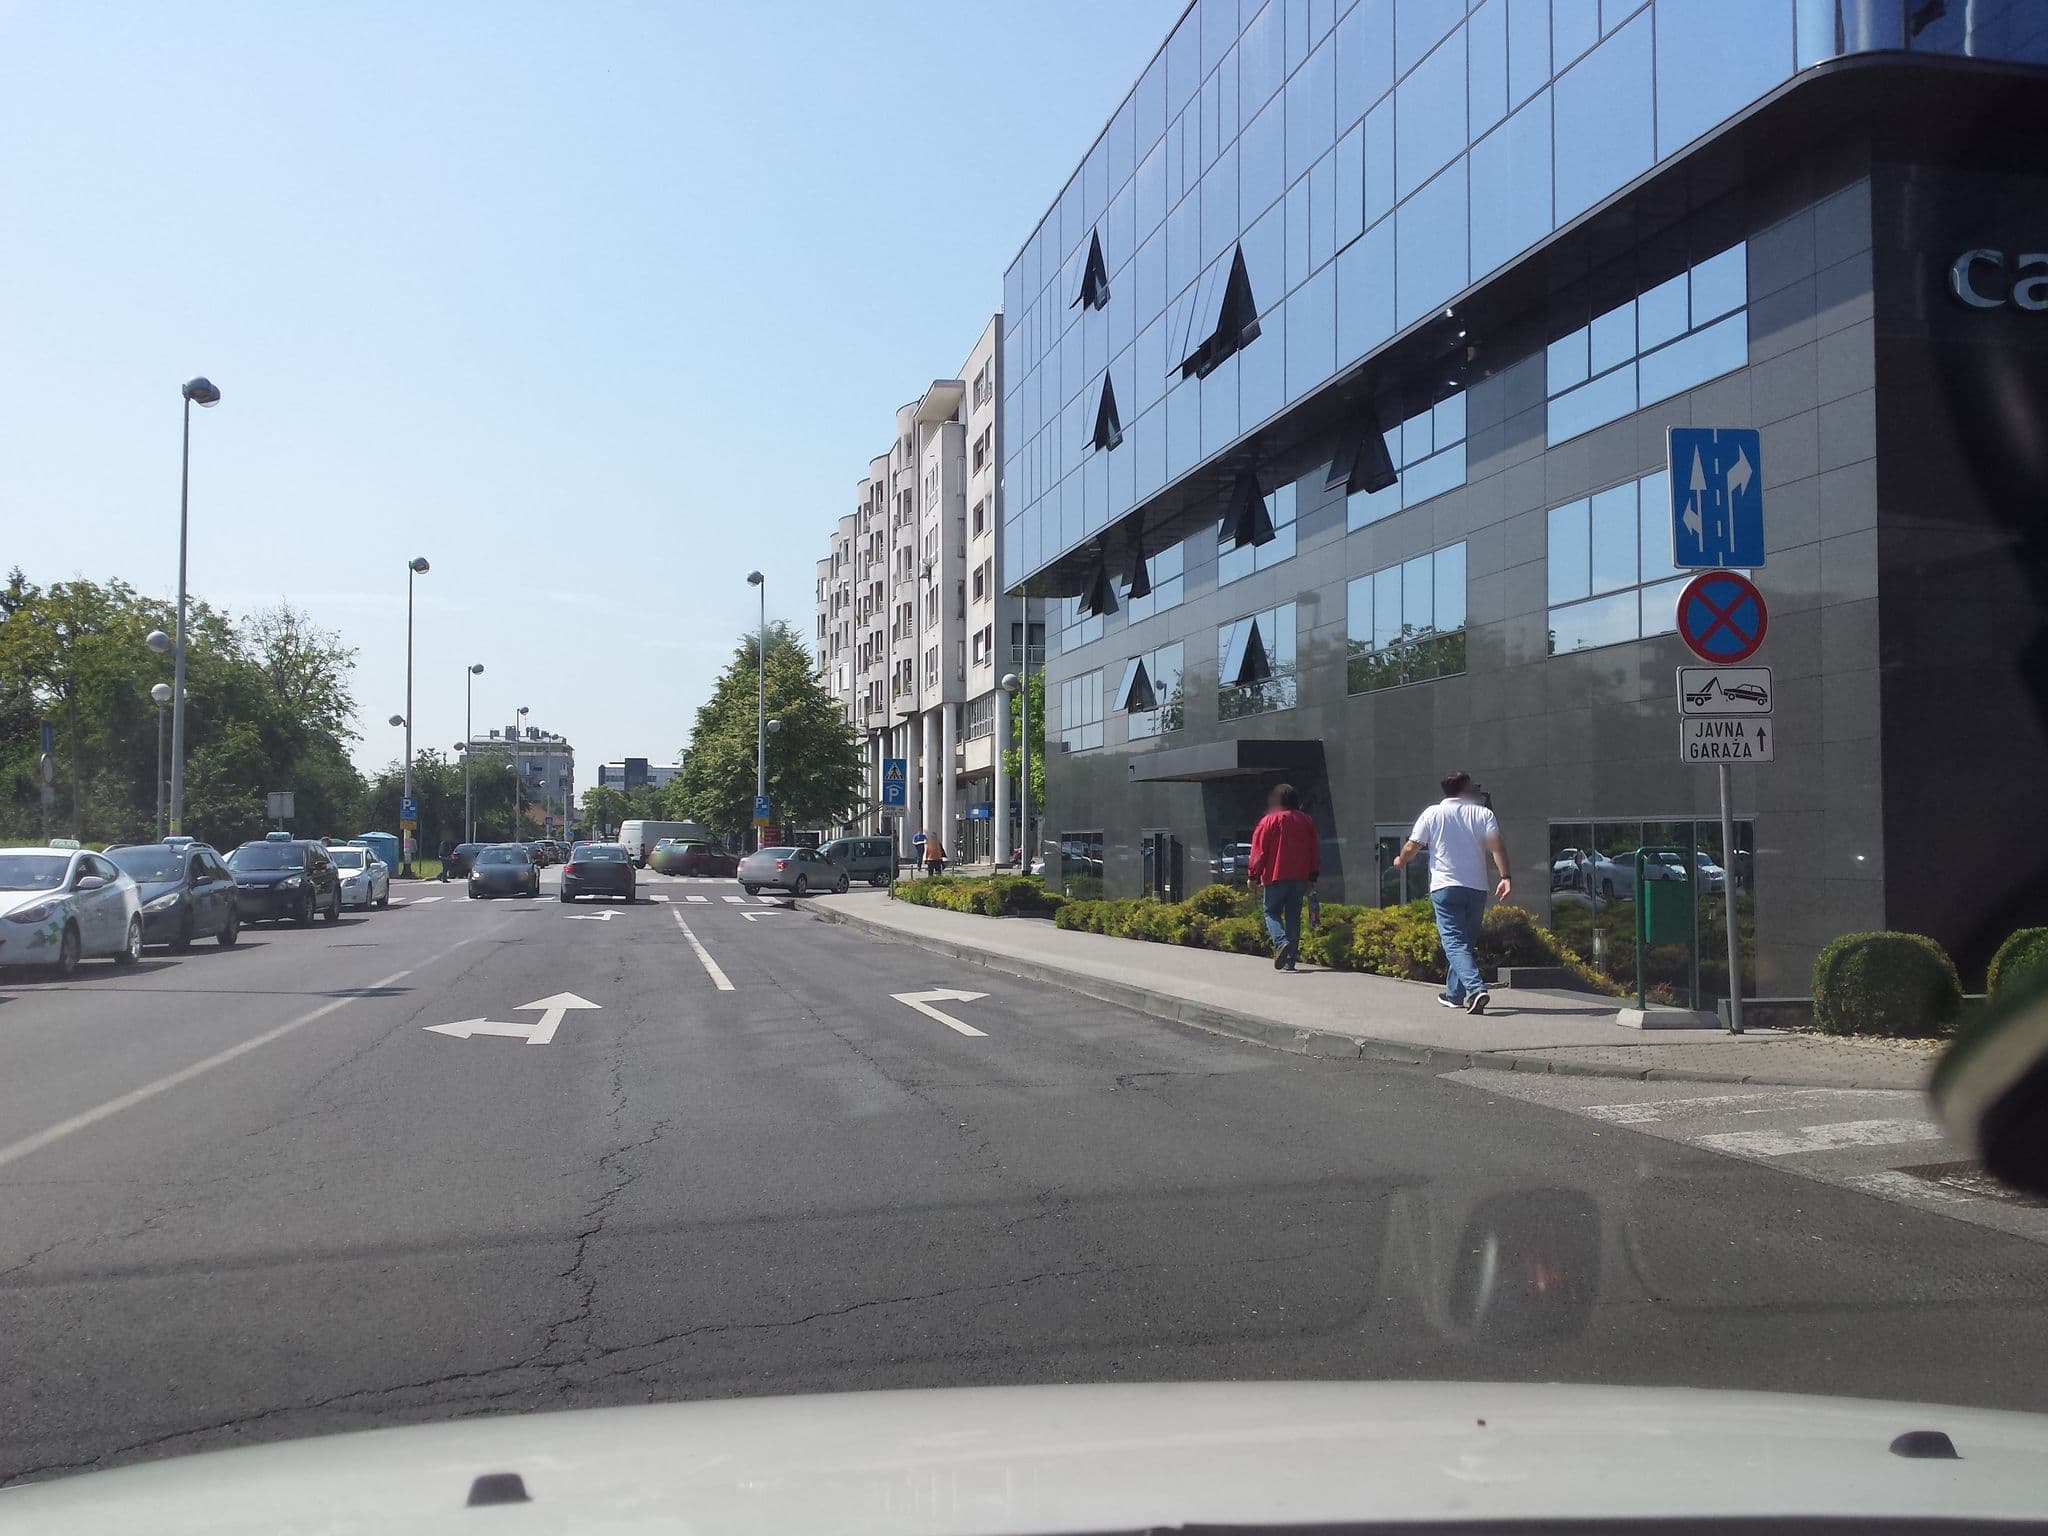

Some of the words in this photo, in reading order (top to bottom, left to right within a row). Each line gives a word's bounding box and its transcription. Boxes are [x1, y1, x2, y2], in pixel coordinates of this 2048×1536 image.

[1695, 722, 1744, 738] JAVNA
[888, 788, 899, 803] P
[403, 799, 411, 810] P
[755, 797, 764, 809] P
